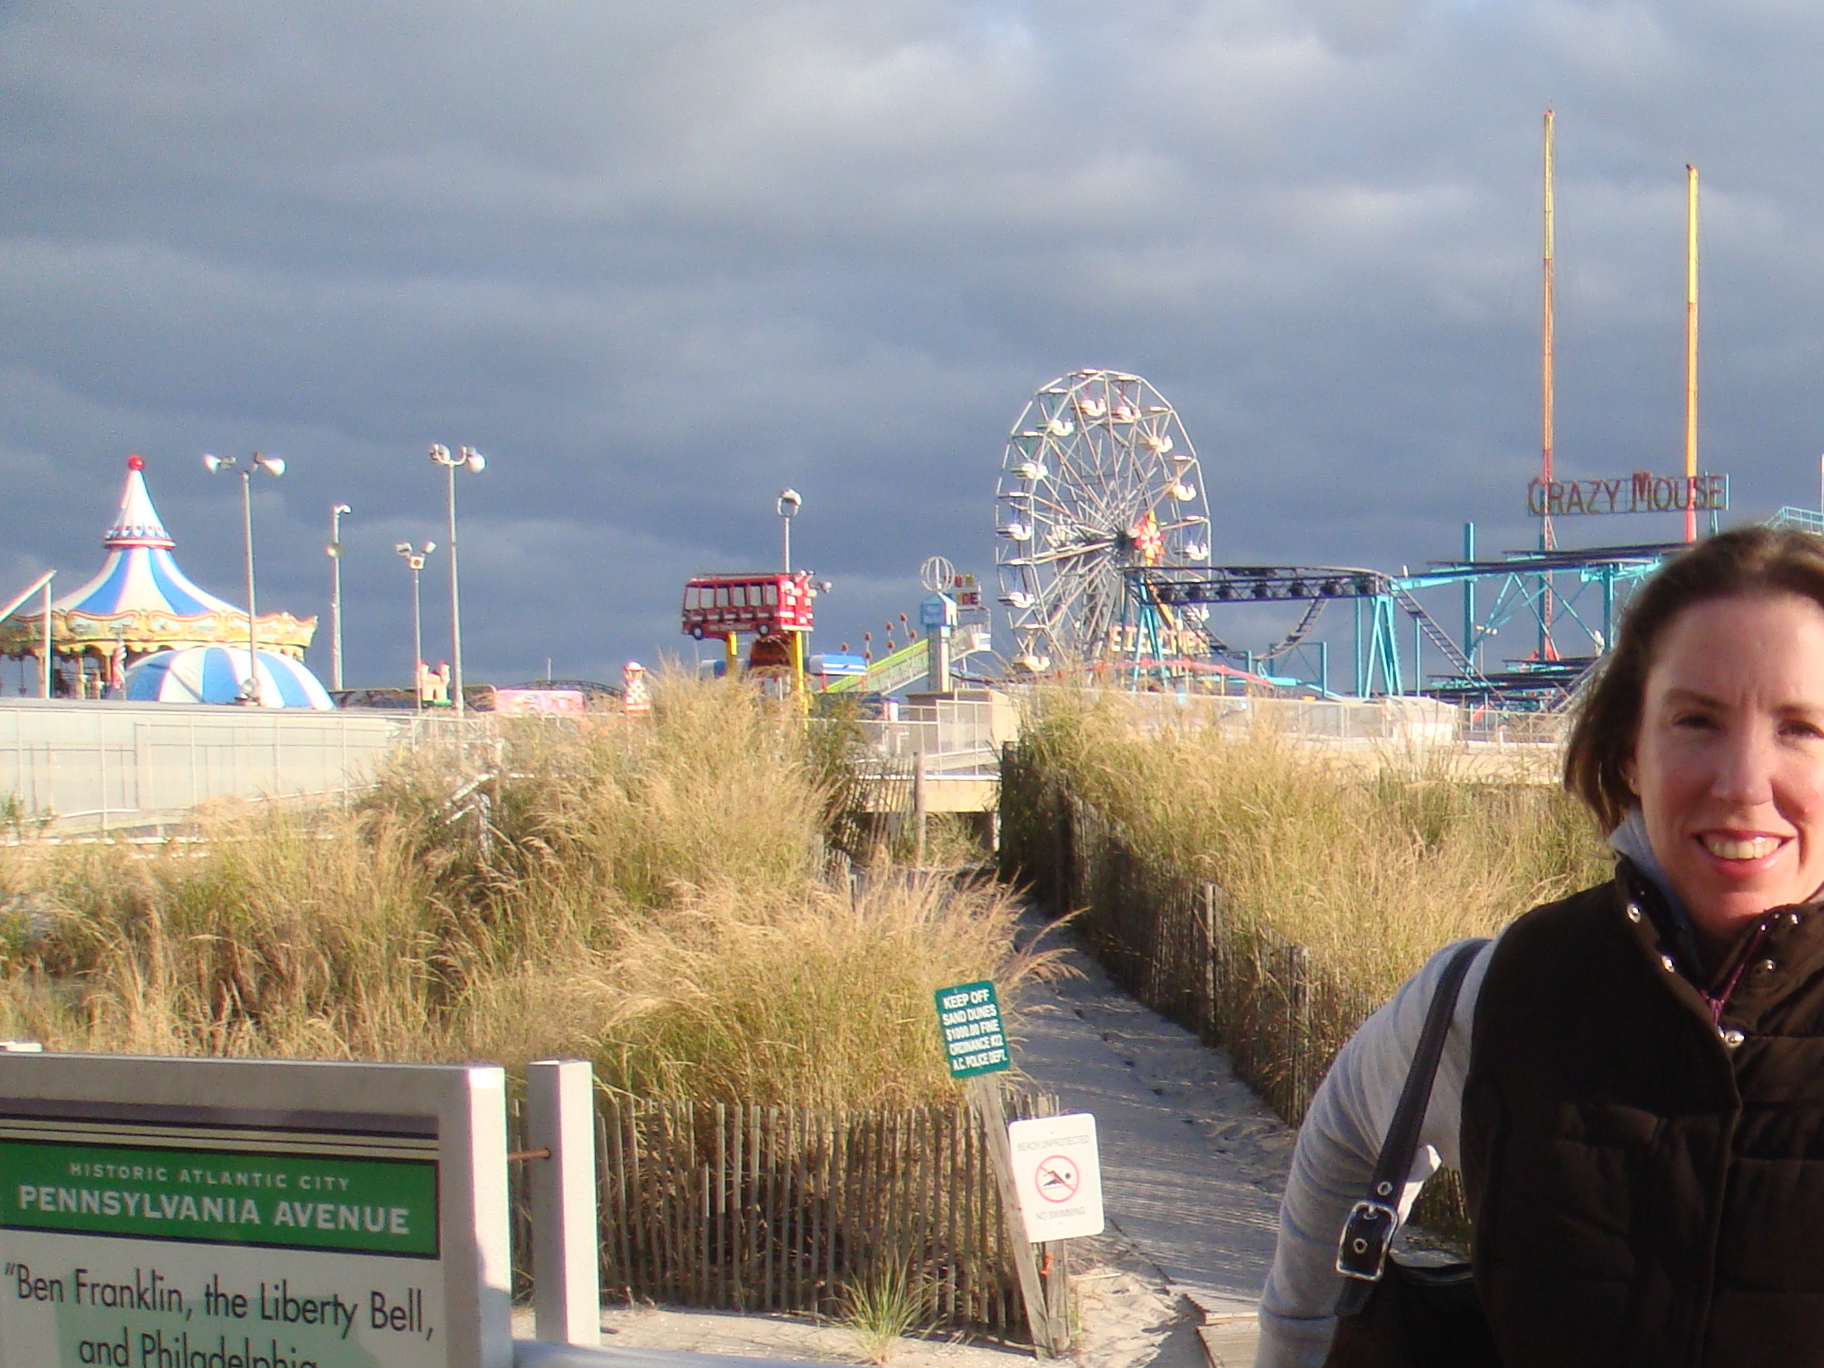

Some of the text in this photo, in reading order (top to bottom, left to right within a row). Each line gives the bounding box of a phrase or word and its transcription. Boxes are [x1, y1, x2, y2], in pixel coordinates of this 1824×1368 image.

[1528, 472, 1726, 516] CRAZY MOUSE
[943, 988, 989, 1009] KEEP OFF
[942, 1003, 997, 1026] SAND DUNES
[980, 1019, 1000, 1034] FINE
[965, 1052, 989, 1068] POLICE
[69, 1162, 350, 1191] HISTORIC ATLANTIC CITY
[18, 1184, 410, 1235] PENNSYLVANIA AVENUE
[1036, 1211, 1047, 1221] NO
[75, 1267, 192, 1322] Franklin,
[205, 1273, 248, 1318] the
[261, 1279, 358, 1340] Liberty
[371, 1287, 433, 1342] Bell,
[79, 1326, 130, 1367] and
